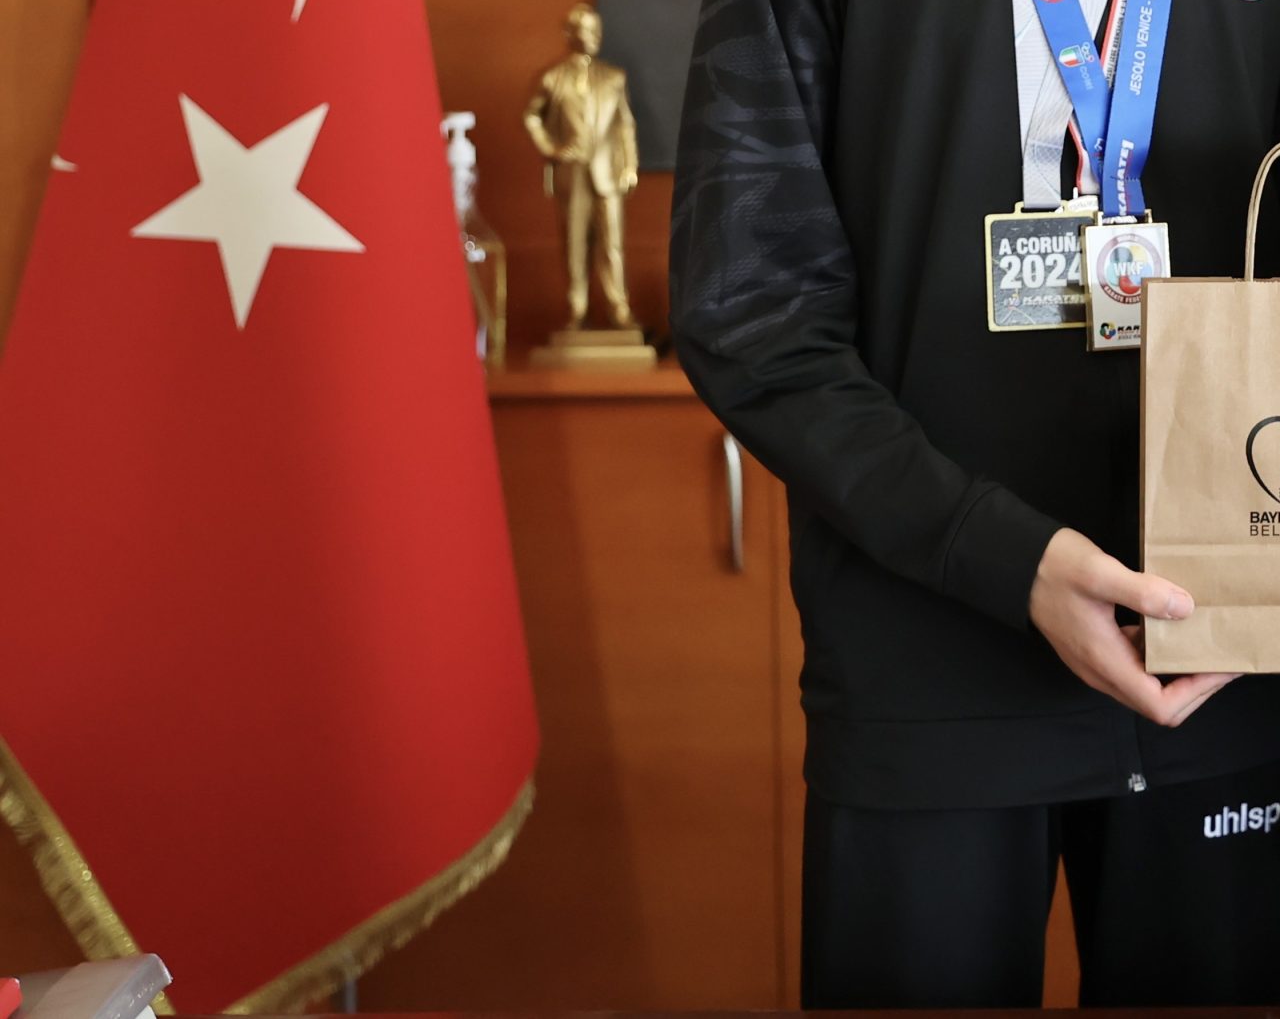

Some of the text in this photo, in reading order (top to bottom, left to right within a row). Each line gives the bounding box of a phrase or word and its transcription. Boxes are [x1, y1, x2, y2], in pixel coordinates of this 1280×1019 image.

[1136, 6, 1153, 48] VENICE
[1130, 50, 1146, 95] JESOLO
[999, 237, 1013, 255] A
[999, 253, 1084, 289] 2024
[1114, 261, 1144, 277] WKF
